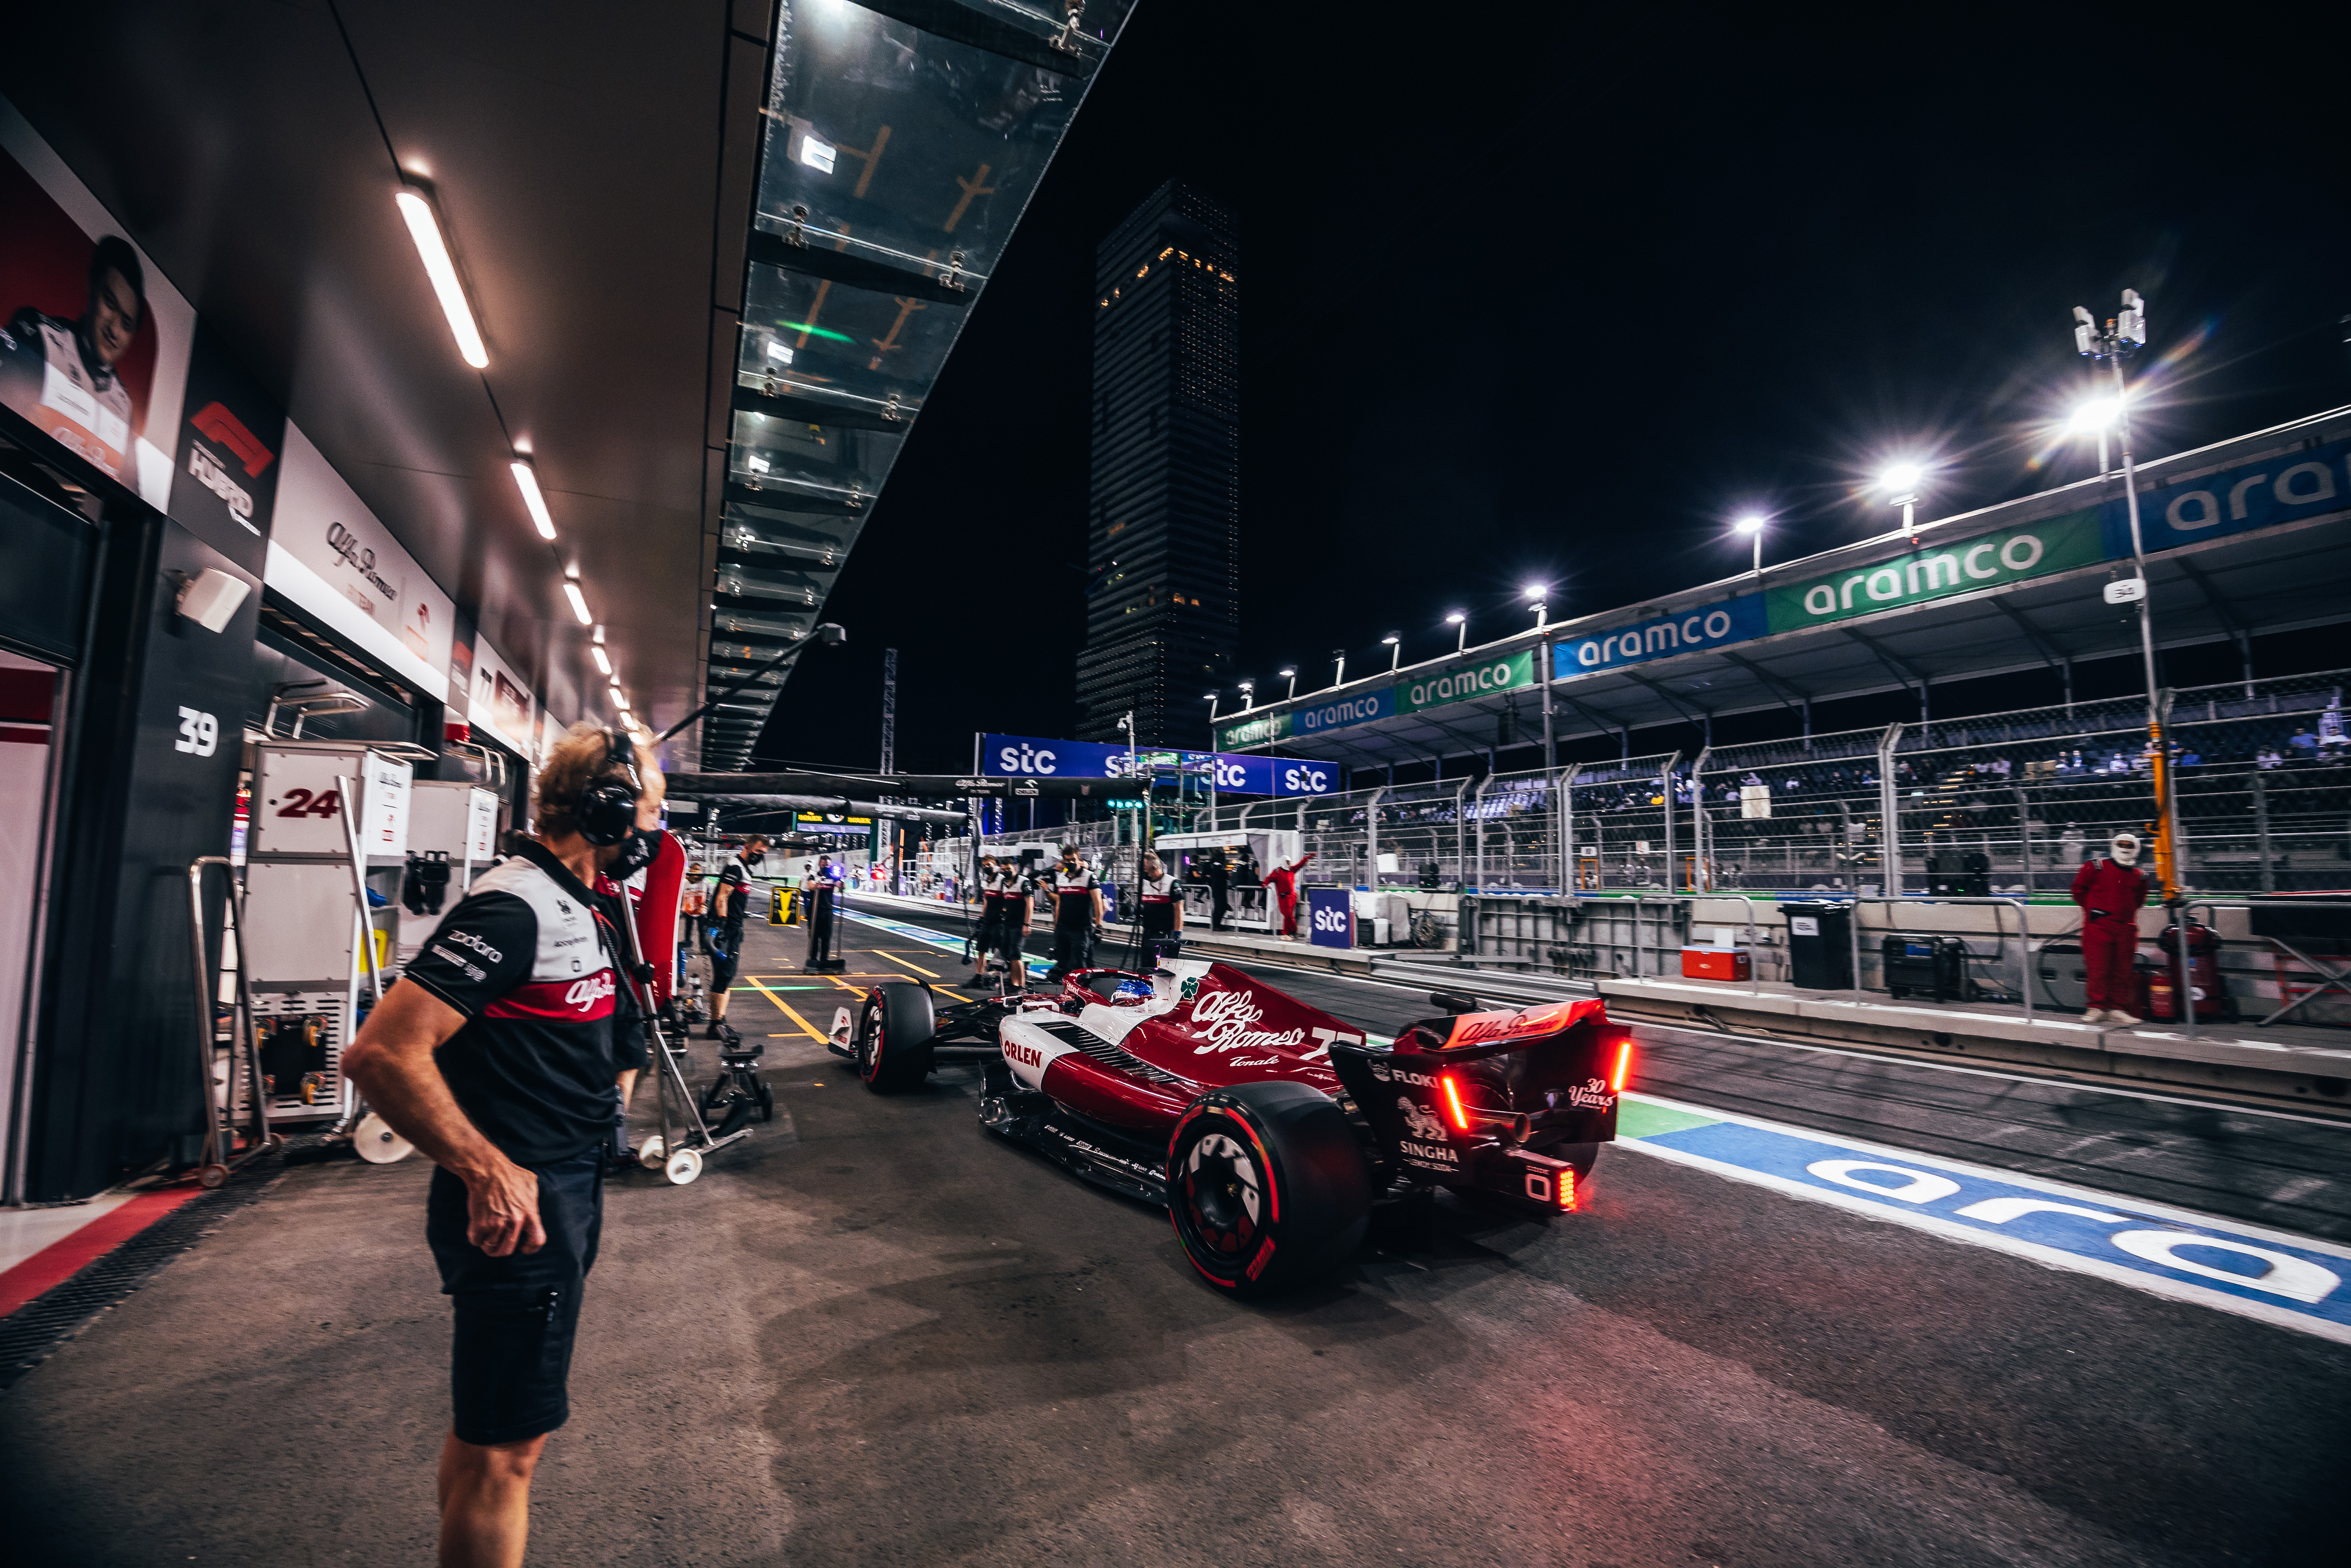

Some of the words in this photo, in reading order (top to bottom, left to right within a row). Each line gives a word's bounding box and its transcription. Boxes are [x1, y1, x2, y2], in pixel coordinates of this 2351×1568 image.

[2166, 452, 2351, 530] ara
[1804, 535, 2043, 614] aramco
[1578, 611, 1731, 666] aramco
[1410, 663, 1511, 704] aramco
[1305, 697, 1379, 728] aramco
[175, 705, 218, 757] 39
[1225, 720, 1282, 745] aramco
[999, 743, 1057, 774] stc
[1200, 759, 1246, 787] stc
[1285, 765, 1327, 792] stc
[276, 788, 340, 818] 24
[1314, 906, 1347, 932] stc
[1191, 990, 1263, 1038] Alfa
[1192, 1019, 1305, 1054] Romeo
[1458, 1020, 1502, 1045] Alfa
[1004, 1040, 1042, 1069] ORLEN
[1229, 1055, 1280, 1067] Tonale
[1391, 1069, 1441, 1089] FLOKI
[1587, 1078, 1606, 1093] 30
[1568, 1086, 1618, 1106] Years
[1400, 1141, 1459, 1162] SINGHA
